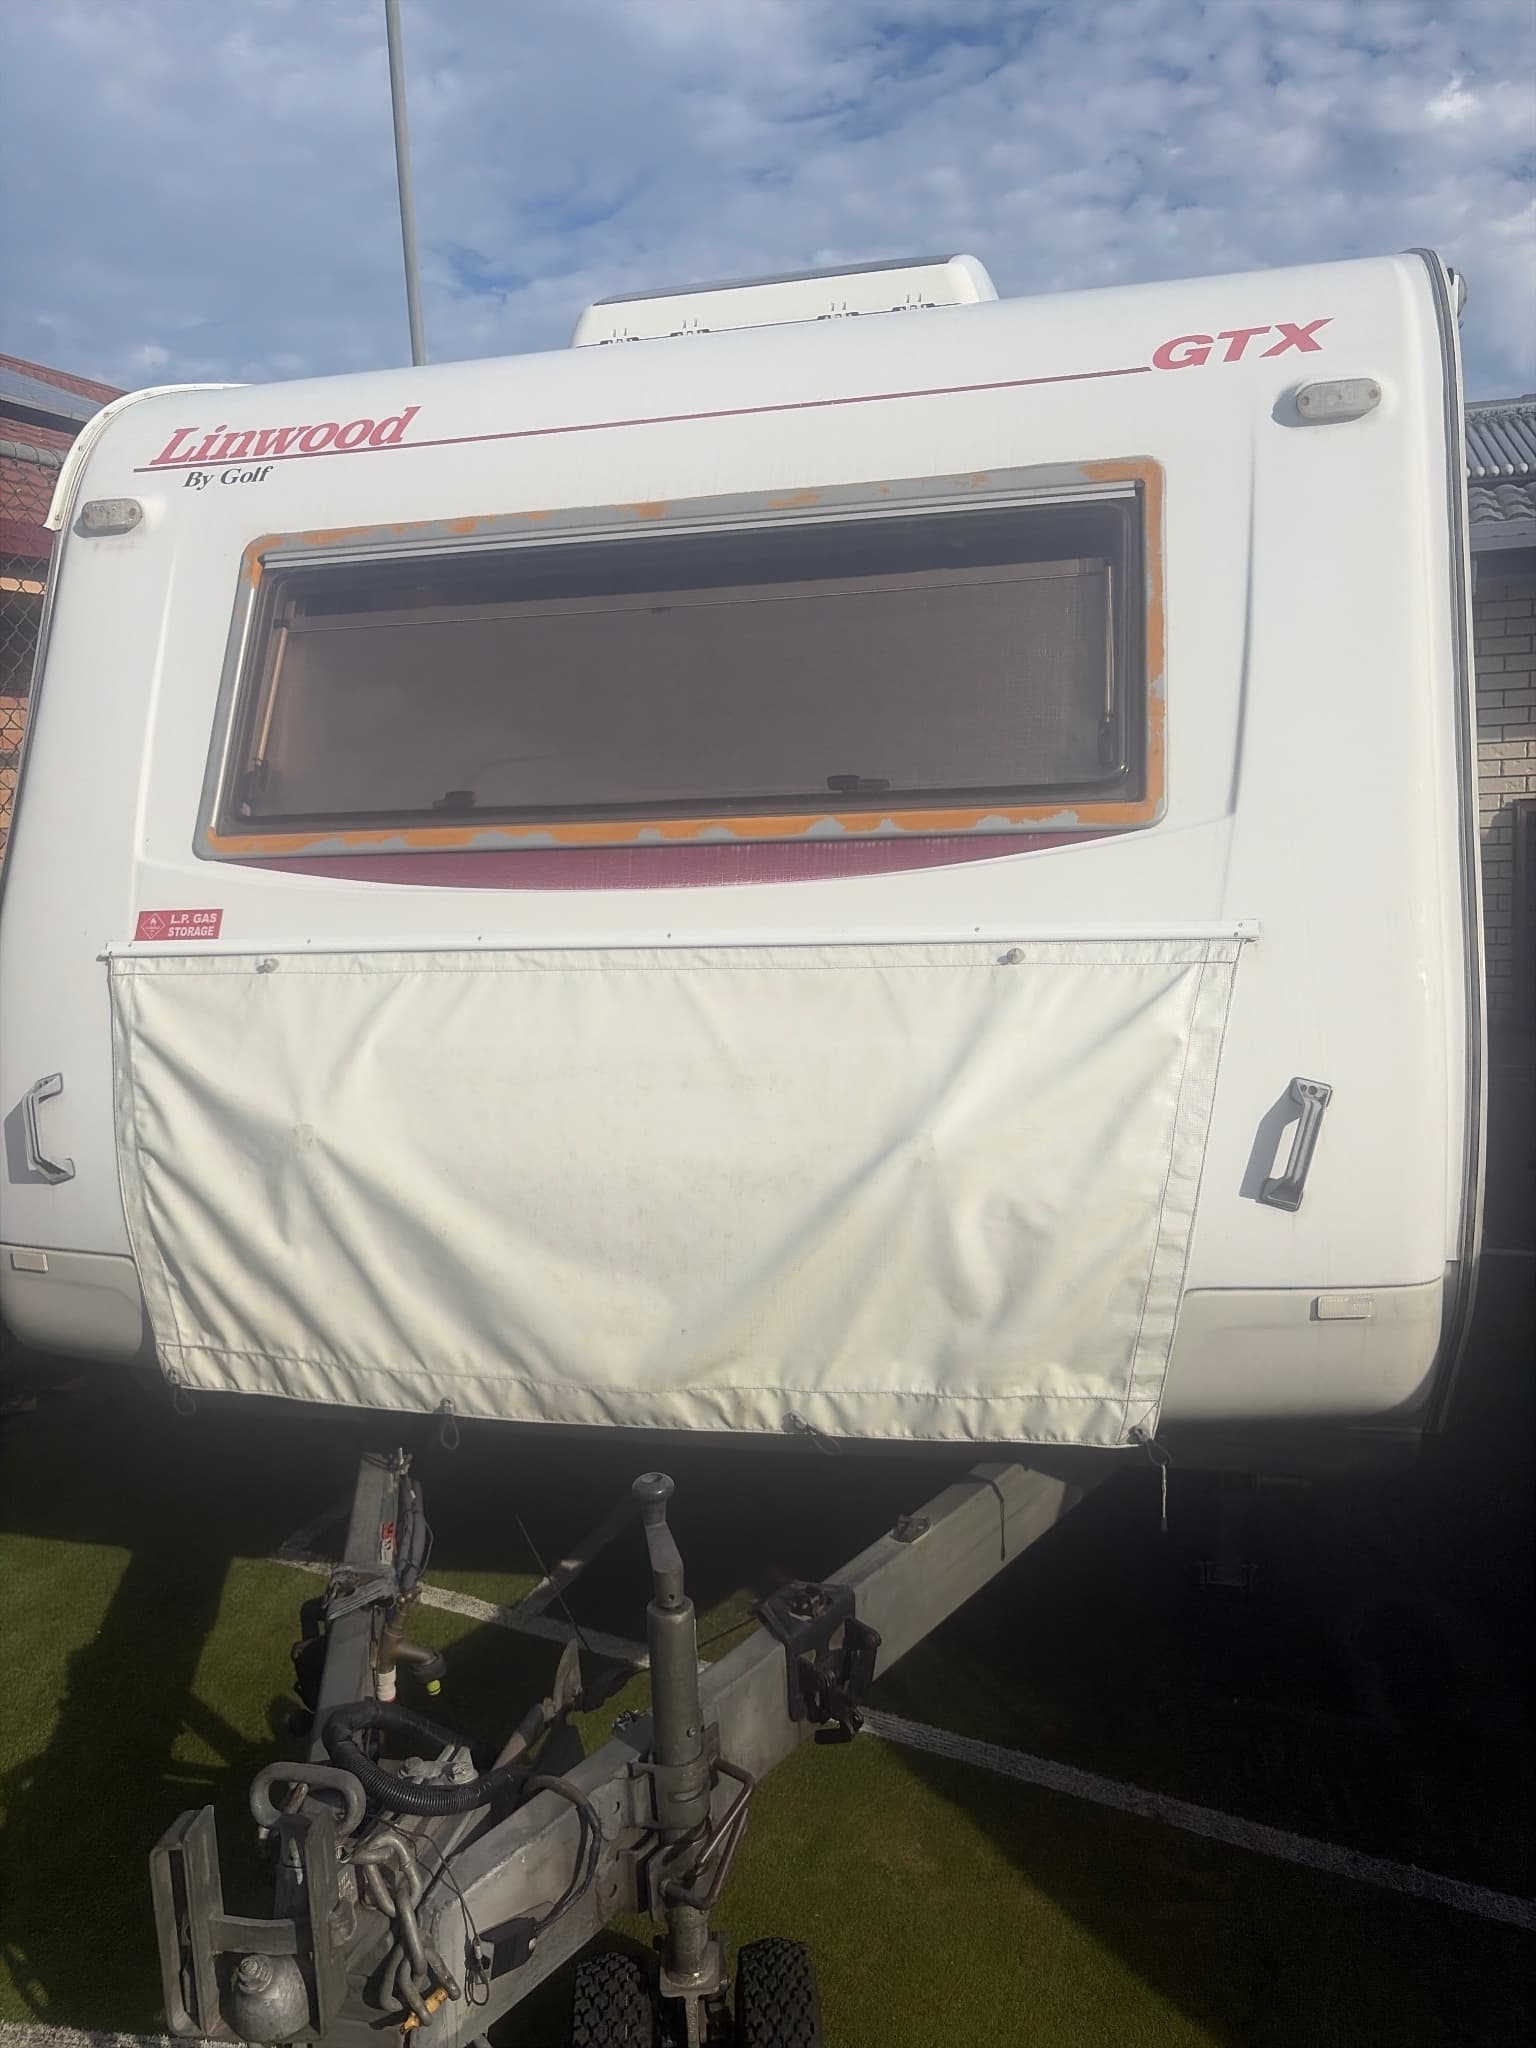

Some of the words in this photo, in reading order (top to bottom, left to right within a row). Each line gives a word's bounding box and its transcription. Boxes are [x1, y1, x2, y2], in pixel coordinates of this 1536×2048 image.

[1152, 318, 1335, 370] GTX
[149, 406, 422, 466] Linwood
[182, 471, 215, 491] By
[220, 465, 274, 485] Golf
[168, 926, 215, 937] STORAGE
[170, 914, 190, 924] L.P.
[193, 913, 217, 924] GAS
